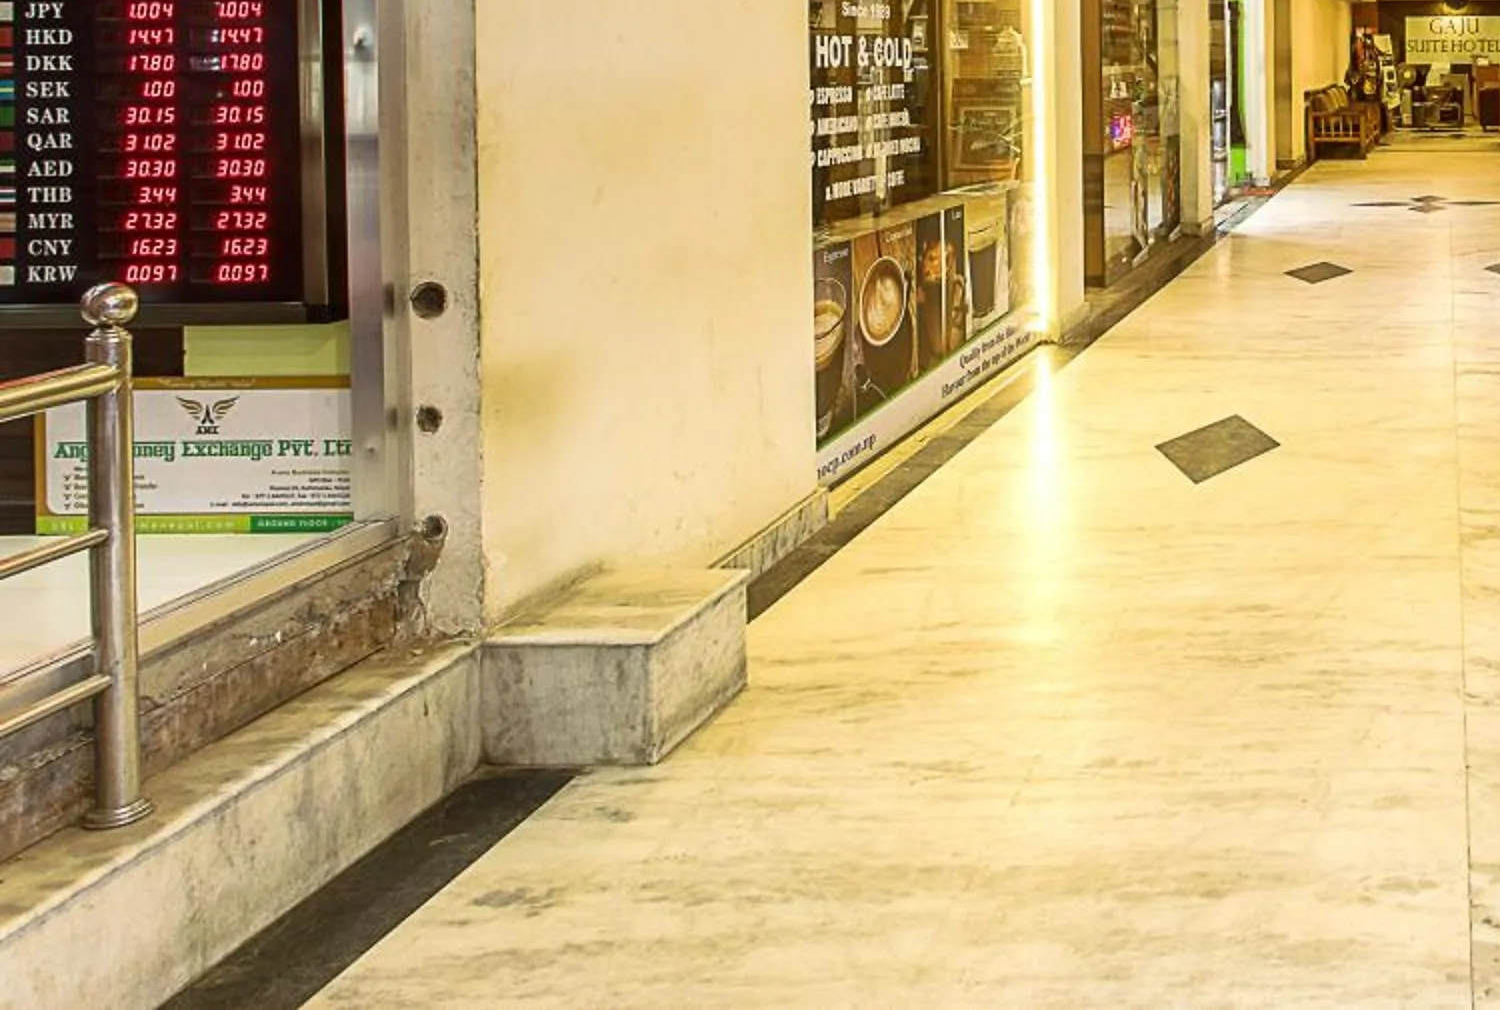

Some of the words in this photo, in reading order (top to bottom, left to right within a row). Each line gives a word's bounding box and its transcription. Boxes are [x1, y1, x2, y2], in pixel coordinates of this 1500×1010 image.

[25, 3, 64, 18] JPY
[1429, 17, 1479, 36] GAJU
[26, 30, 73, 44] HKD
[816, 35, 853, 68] HOT
[858, 35, 869, 67] &
[1407, 39, 1449, 53] SUITE
[26, 56, 73, 70] DKK
[26, 82, 70, 97] SEK
[26, 108, 70, 124] SAR
[27, 133, 73, 151] QAR
[27, 161, 73, 176] AED
[27, 187, 72, 202] THB
[28, 214, 74, 228] MYR
[28, 240, 72, 254] CNY
[27, 266, 77, 282] KRW
[131, 442, 176, 462] oney
[181, 441, 273, 462] Exchange
[277, 440, 319, 457] Pvt.
